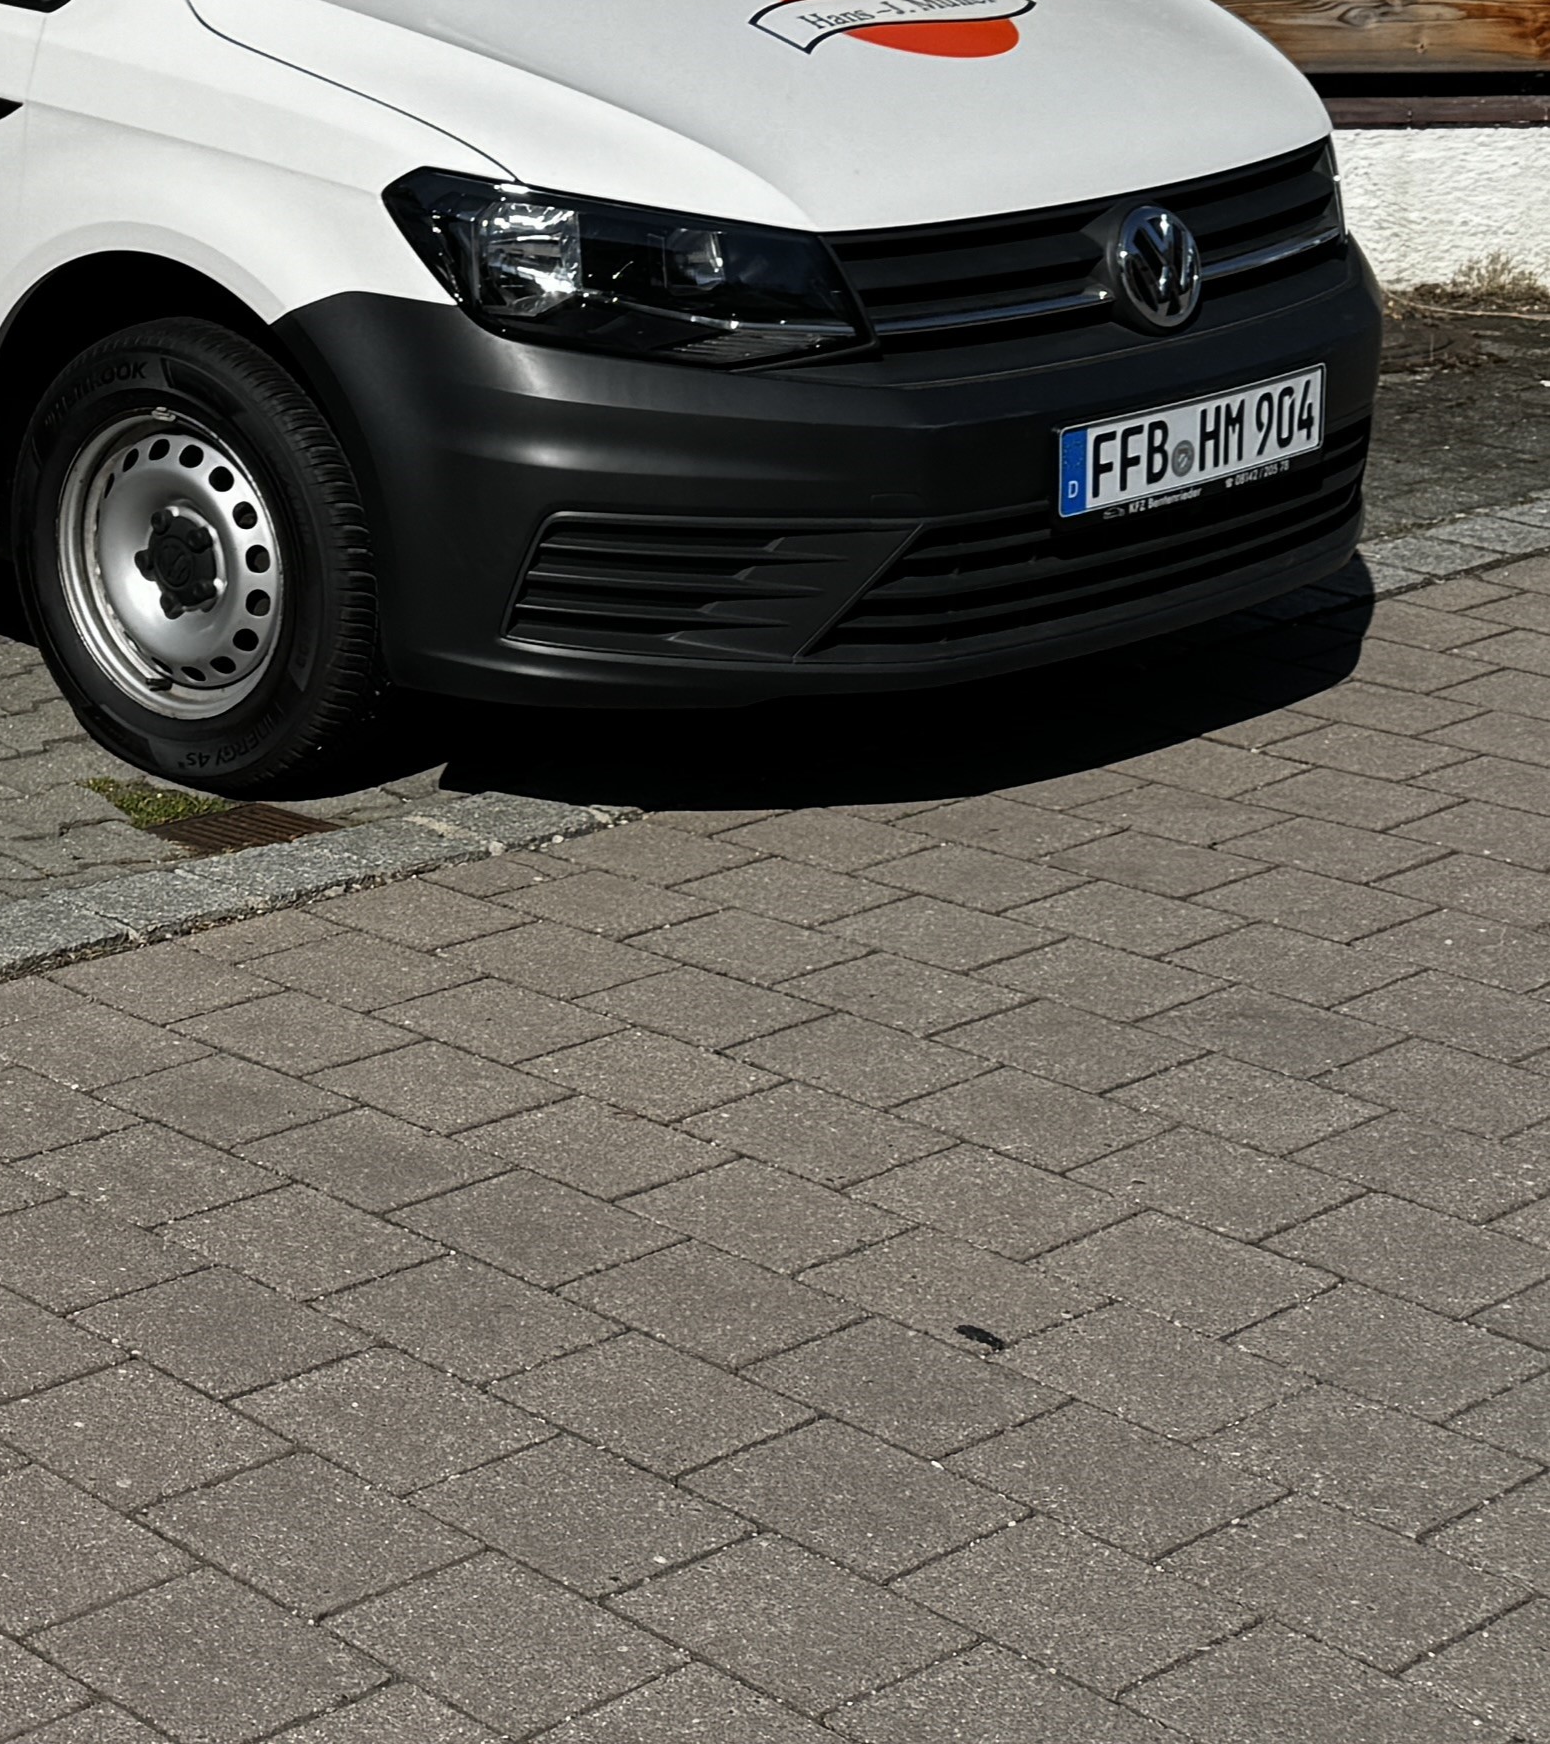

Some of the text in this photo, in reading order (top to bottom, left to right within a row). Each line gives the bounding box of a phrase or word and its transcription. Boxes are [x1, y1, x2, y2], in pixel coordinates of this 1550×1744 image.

[797, 8, 876, 31] Hans
[1067, 378, 1315, 499] D FFB HM 904
